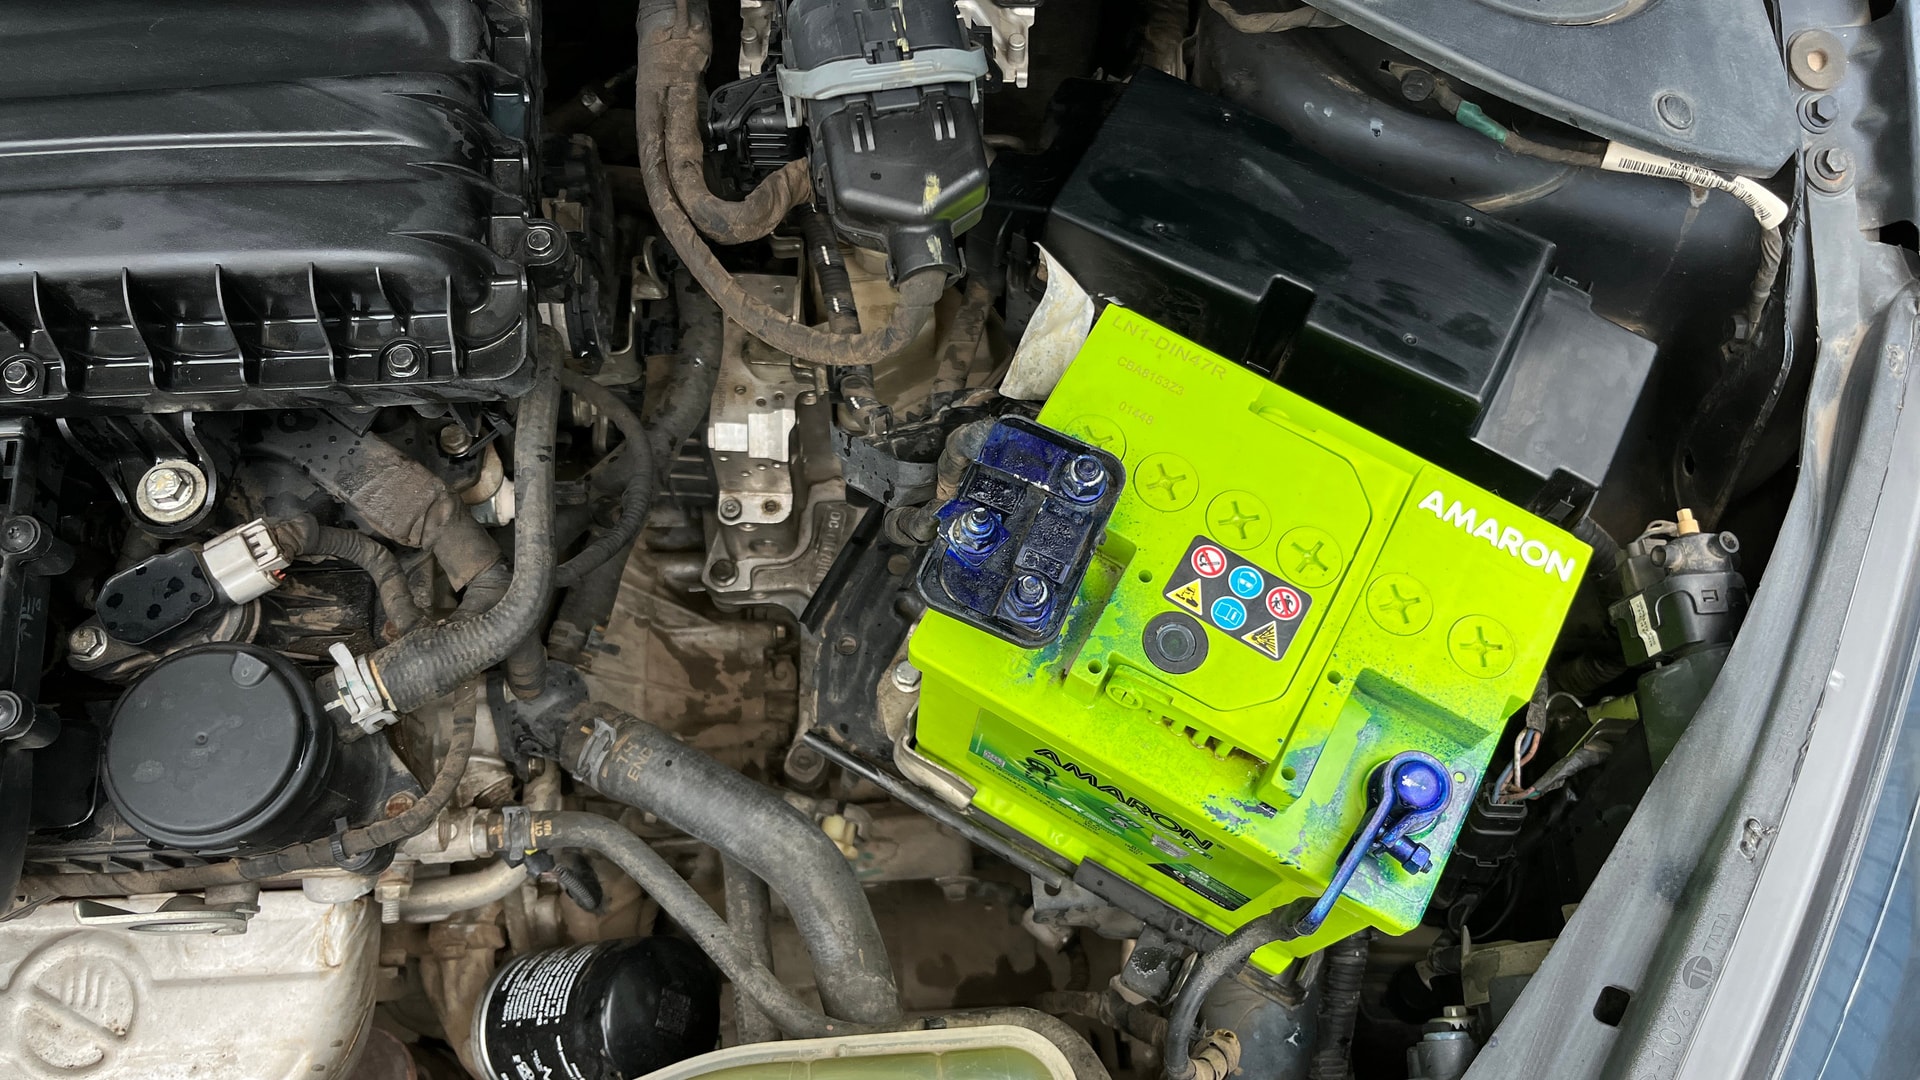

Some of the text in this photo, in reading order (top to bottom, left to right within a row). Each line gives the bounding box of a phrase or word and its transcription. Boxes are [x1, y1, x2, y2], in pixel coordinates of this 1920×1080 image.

[1692, 167, 1709, 176] INDIA
[1112, 315, 1227, 380] LN1-DIN47R
[1418, 490, 1575, 582] AMARON
[1033, 748, 1214, 851] AMARON
[1702, 912, 1732, 951] TATA
